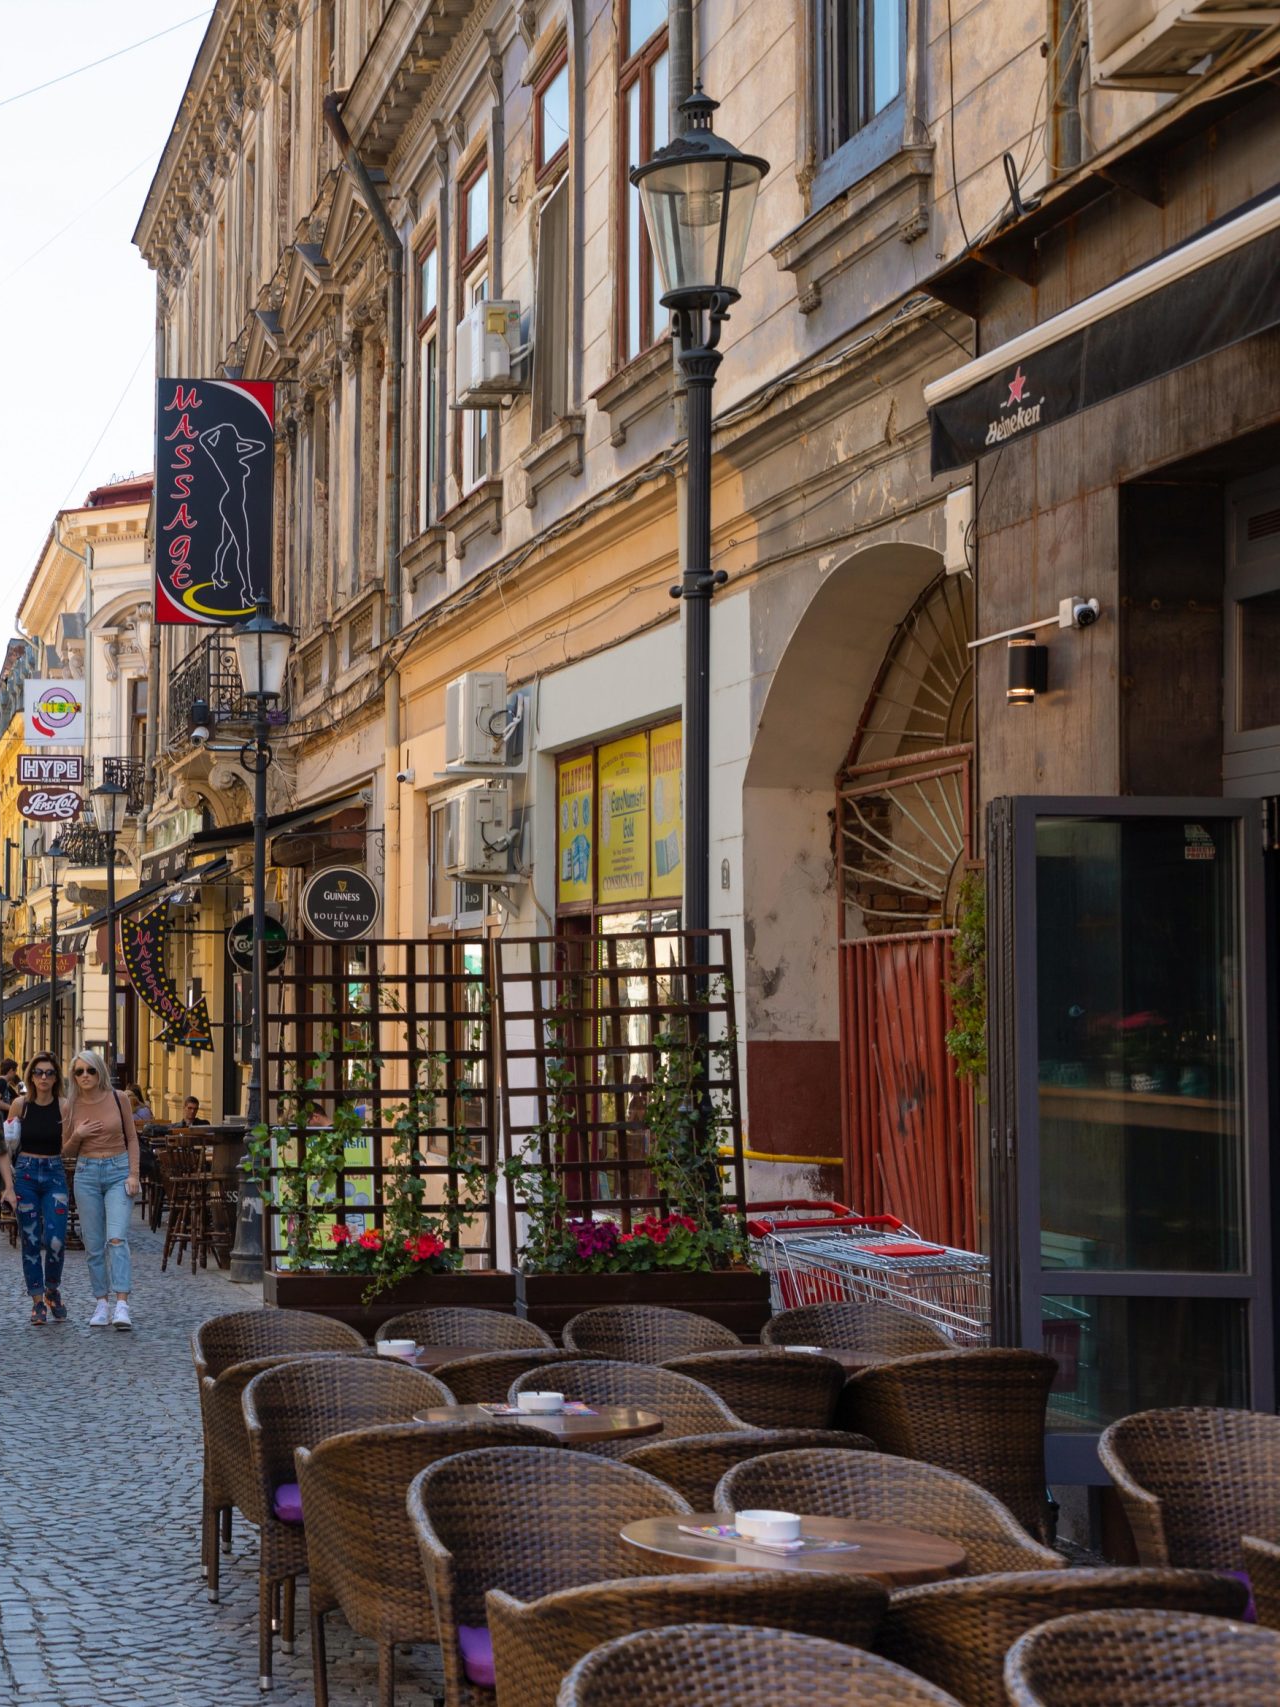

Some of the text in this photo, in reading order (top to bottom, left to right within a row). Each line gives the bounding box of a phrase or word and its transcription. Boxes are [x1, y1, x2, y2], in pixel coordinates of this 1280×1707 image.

[985, 403, 1041, 446] Heineken
[164, 385, 202, 589] MASSAGE
[24, 760, 78, 778] HYPE
[323, 890, 360, 902] GUINNESS
[131, 929, 183, 1021] MASSAGE
